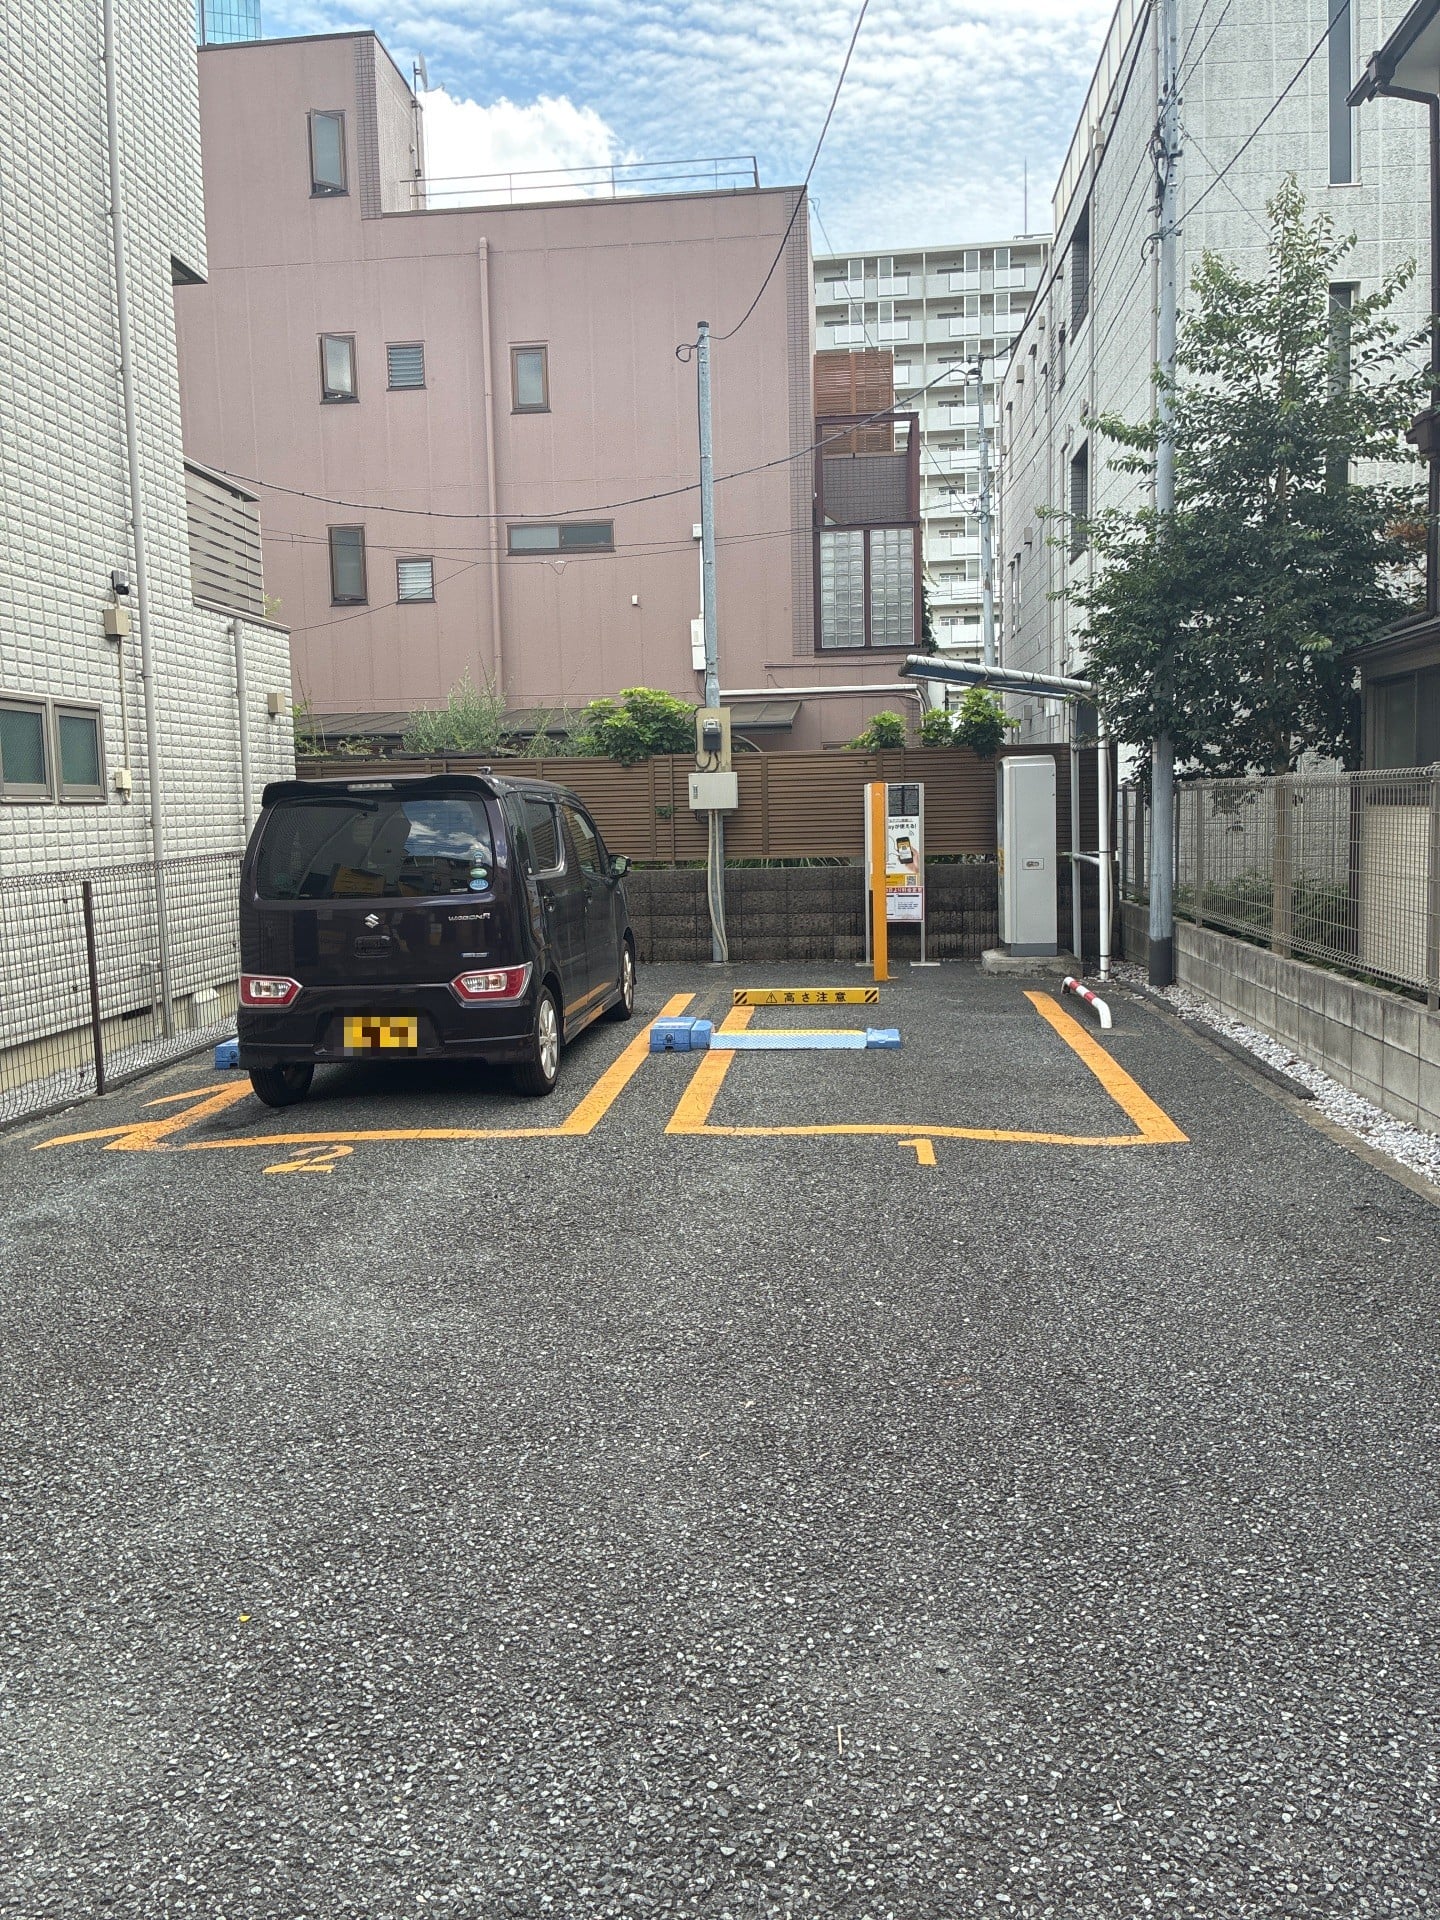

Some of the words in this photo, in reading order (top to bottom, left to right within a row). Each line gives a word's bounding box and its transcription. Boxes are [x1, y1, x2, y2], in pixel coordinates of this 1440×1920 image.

[784, 991, 846, 1003] 高さ注意
[262, 1145, 354, 1174] 2
[897, 1138, 938, 1165] 1
